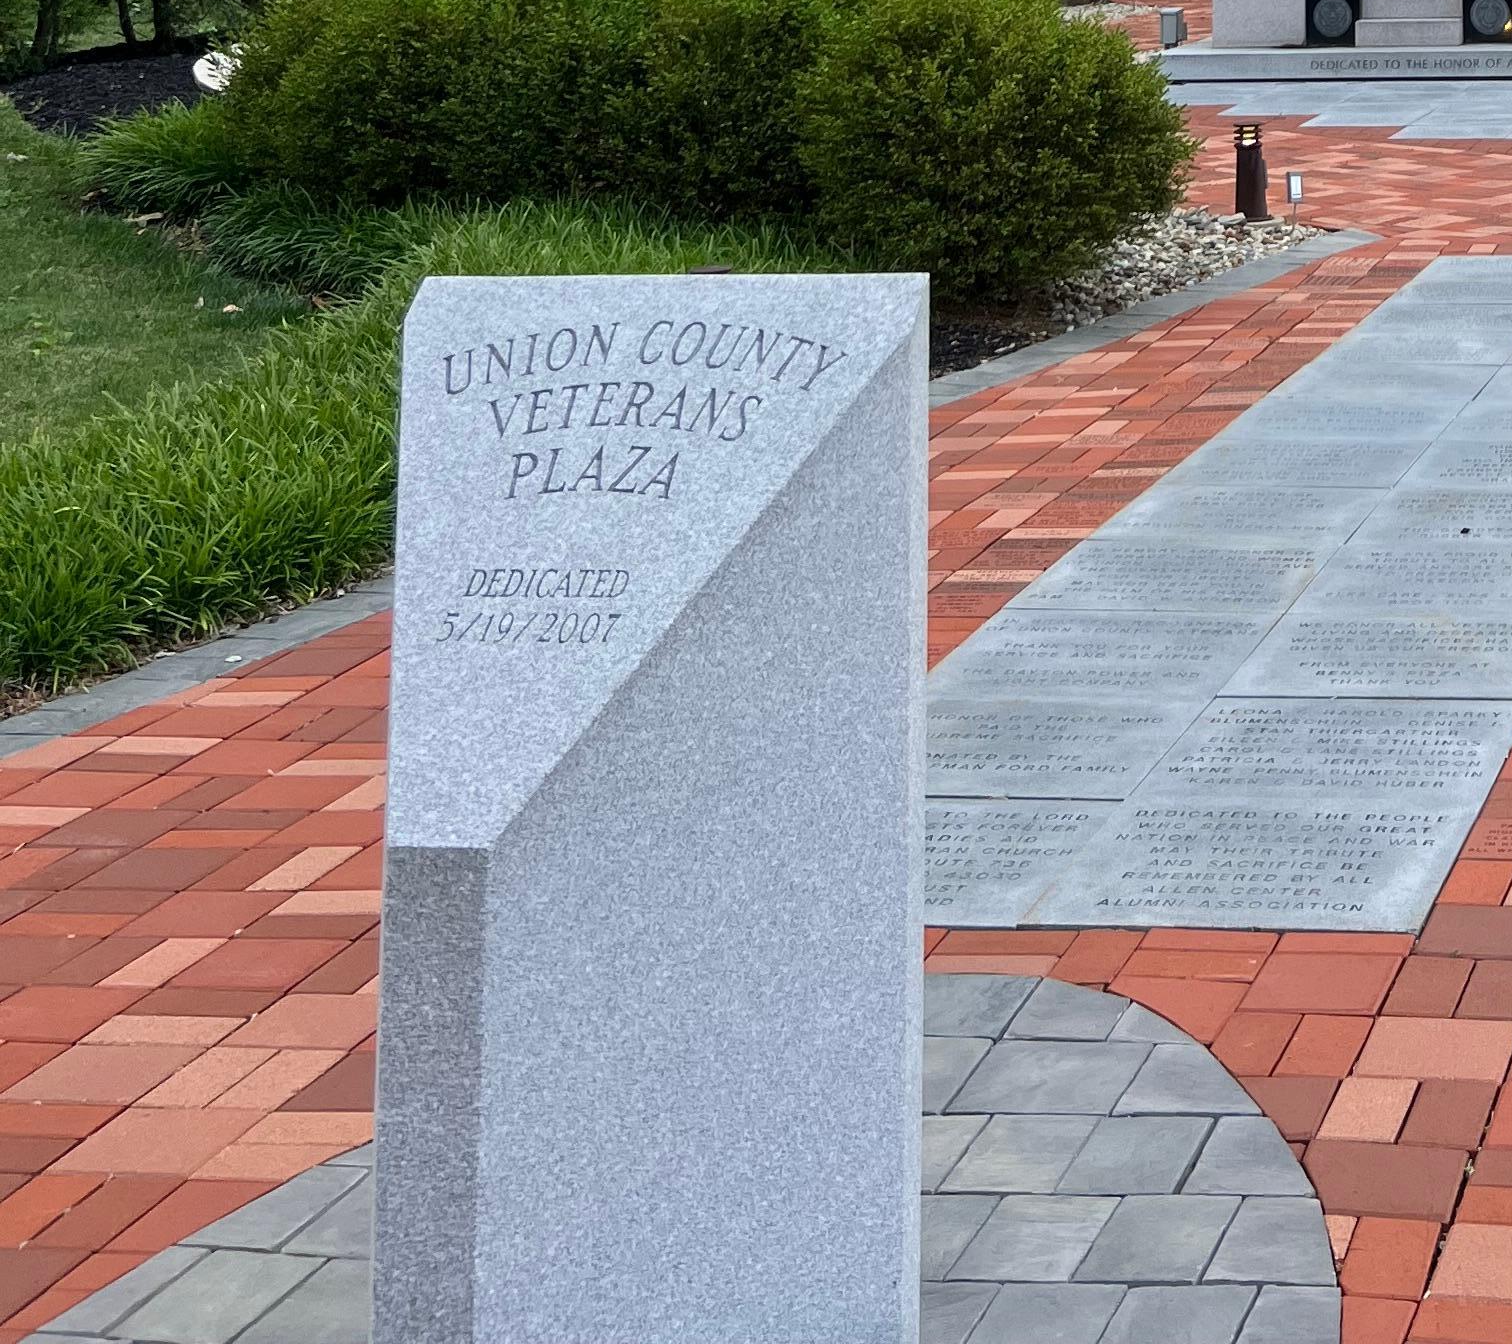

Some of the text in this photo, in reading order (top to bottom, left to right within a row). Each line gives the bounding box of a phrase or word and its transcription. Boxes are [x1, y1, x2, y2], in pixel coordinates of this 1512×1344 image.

[1310, 59, 1378, 70] DEDICATED
[1383, 59, 1401, 70] TO
[1406, 59, 1428, 69] THE
[1433, 58, 1480, 69] HONOR
[1485, 58, 1501, 69] OF
[442, 319, 848, 395] UNION COUNTY
[488, 381, 764, 443] VETERANS
[504, 444, 680, 500] PLAZA
[463, 567, 630, 599] DEDICATED
[436, 612, 622, 644] 5/19/2007
[1182, 755, 1275, 764] PATRICIA
[995, 763, 1129, 773] FORD FAMILY
[1168, 766, 1234, 775] WAYNE
[943, 811, 1089, 822] TO THE LORD
[1136, 810, 1449, 823] DEDICATED TO THE PEOPLE
[977, 822, 1080, 833] FOREVER
[1139, 822, 1432, 834] WHO SERVED OUR GREAT
[1000, 835, 1038, 844] AID
[1115, 833, 1436, 847] NATION IN PEACE AND WAR
[982, 846, 1073, 857] CHURCH
[1150, 846, 1384, 858] MAY THEIR TRIBUTE
[1148, 859, 1369, 871] AND SACRIFICE BE
[1121, 871, 1374, 885] REMEMBERED BY ALL
[1142, 885, 1321, 897] ALLEN CENTER
[1097, 898, 1364, 912] ALUMNI ASSOCIATION
